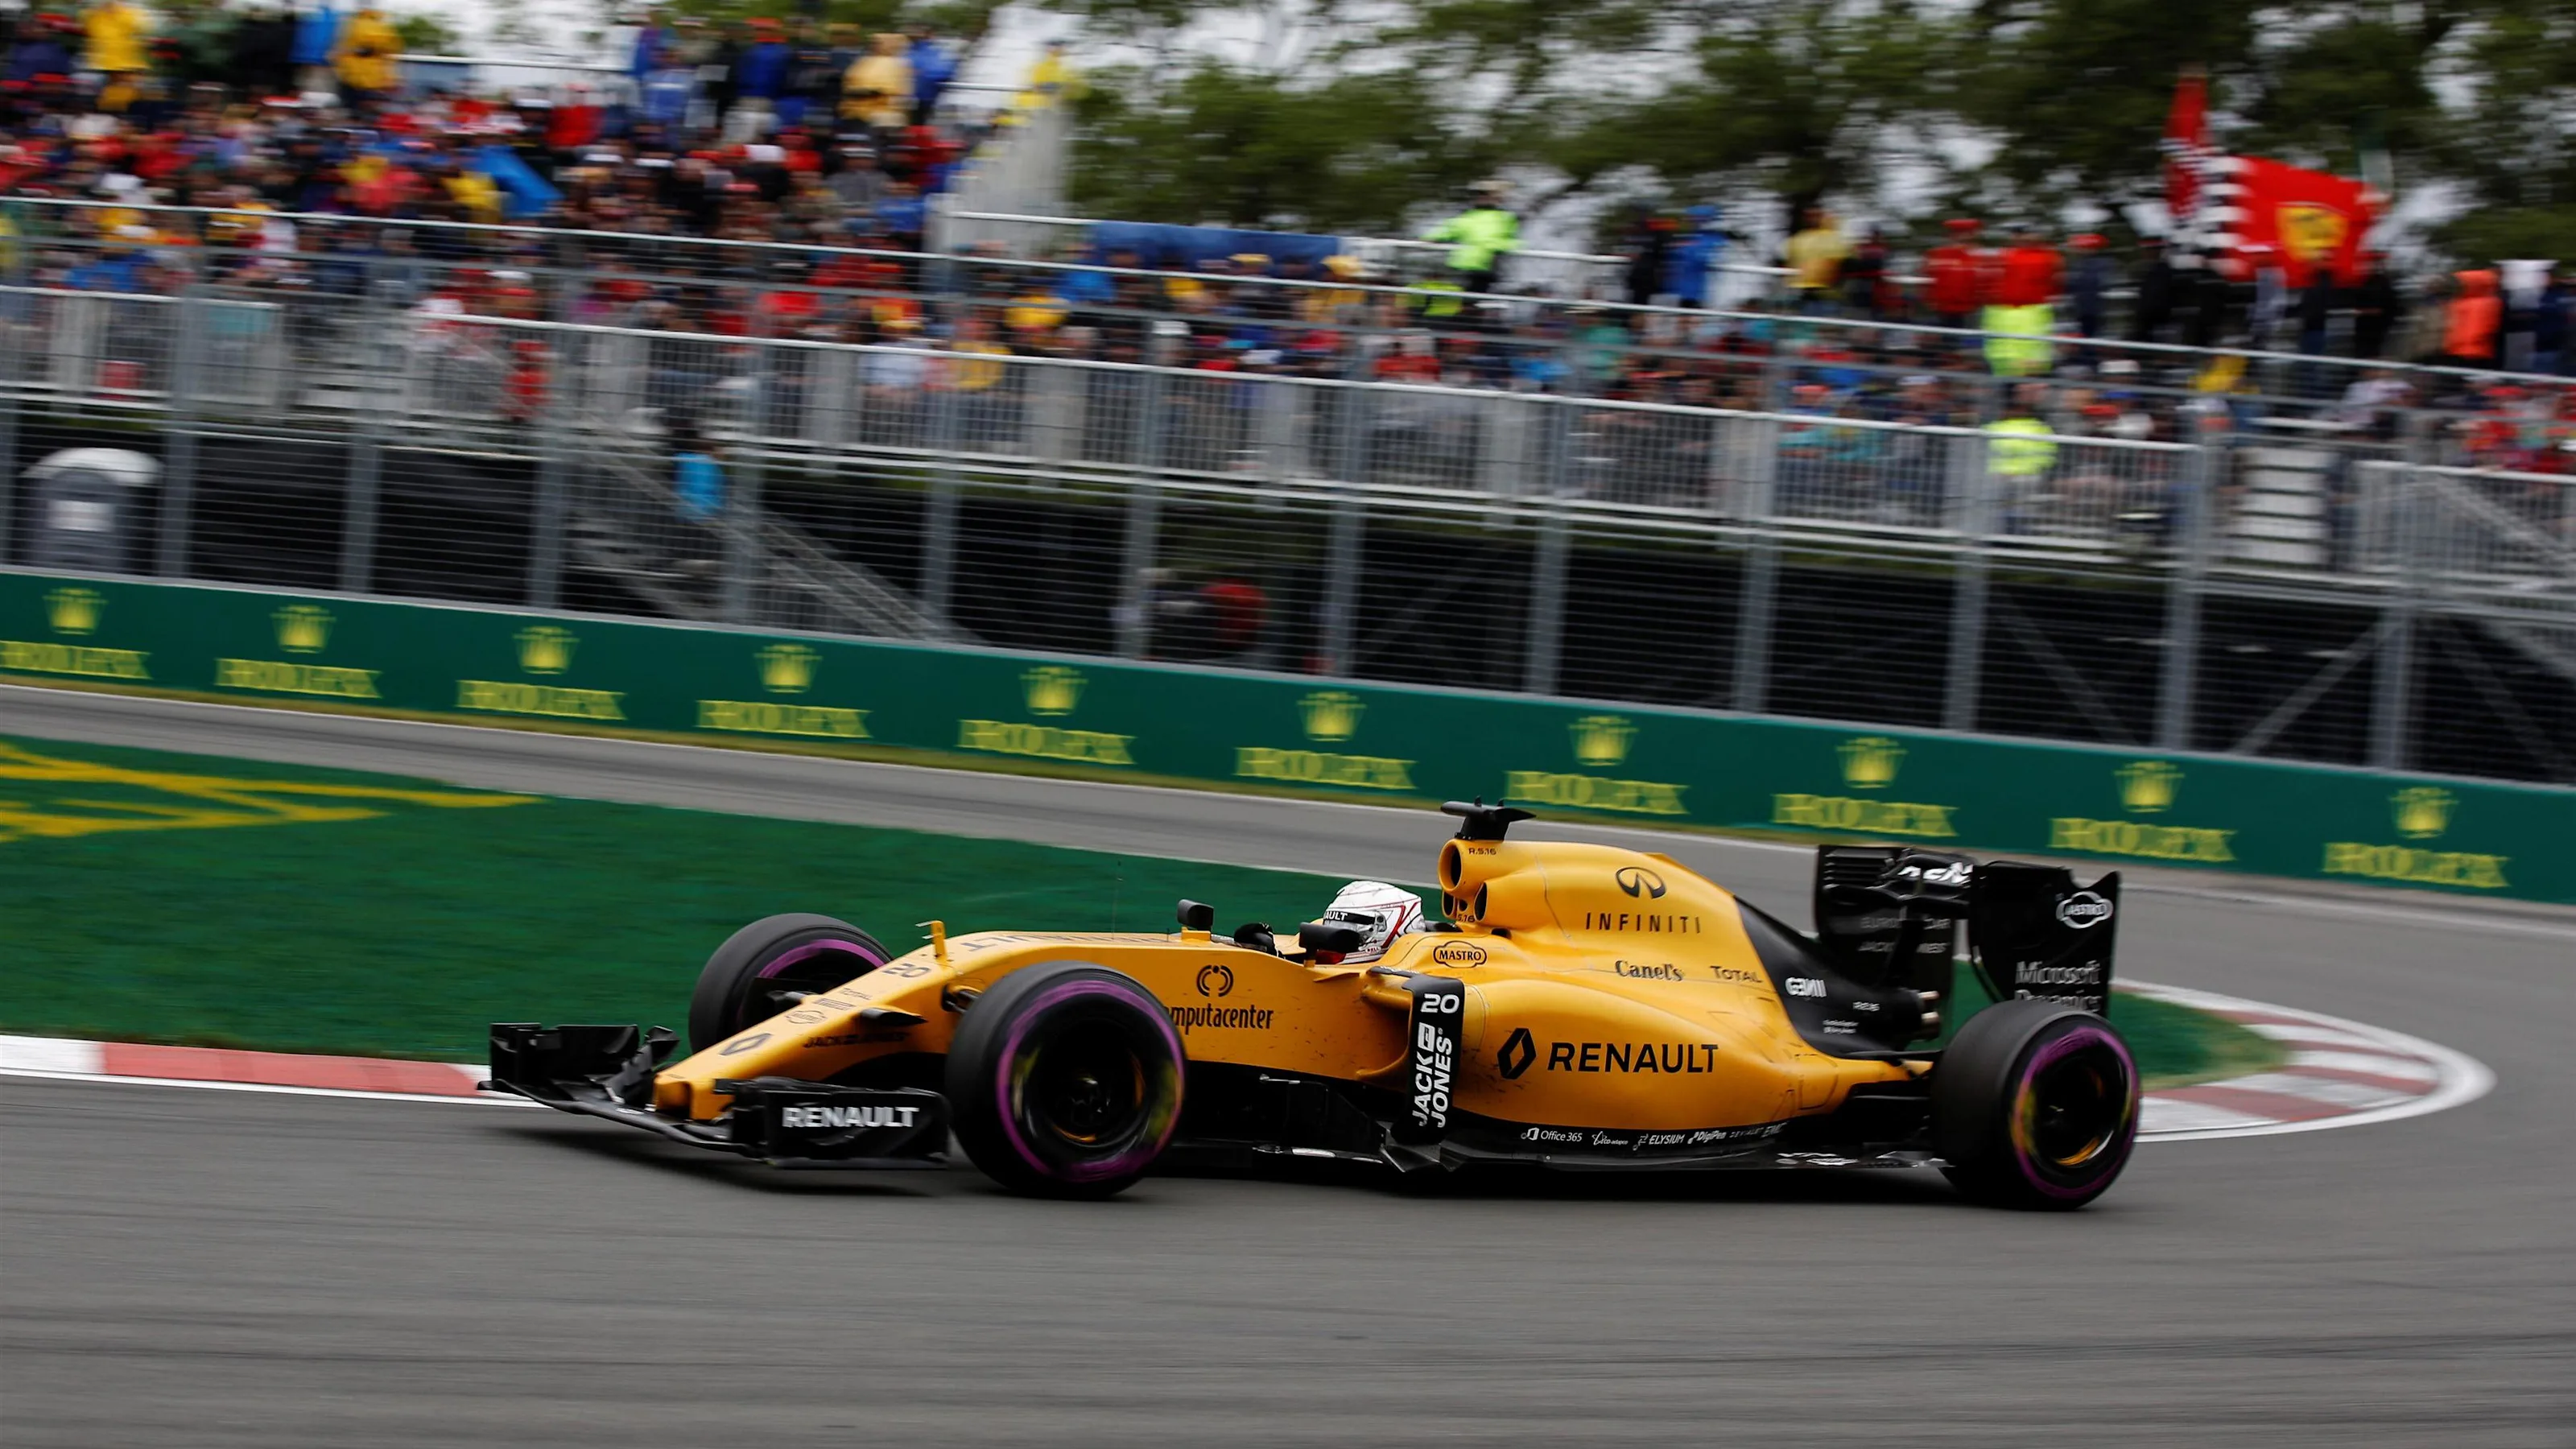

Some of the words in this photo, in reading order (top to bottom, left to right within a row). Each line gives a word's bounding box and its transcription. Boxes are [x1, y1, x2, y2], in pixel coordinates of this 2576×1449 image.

[217, 658, 380, 698] ROLEX
[458, 680, 625, 720] ROLEX
[700, 700, 871, 738] ROLEX
[960, 719, 1135, 765] ROLEX
[1236, 746, 1415, 789] ROLEX
[1507, 770, 1688, 815] ROLEX
[1773, 793, 1958, 836] ROLEX
[2054, 817, 2234, 861] ROLEX
[2325, 843, 2508, 888] ROLEX
[1585, 912, 1701, 934] INFINITI
[1439, 950, 1482, 961] MASTRO
[1615, 960, 1684, 982] Canel's
[2015, 960, 2101, 985] Microsoft
[1710, 965, 1763, 984] TOTAL
[1420, 993, 1459, 1013] 20
[1547, 1043, 1718, 1073] RENAULT
[1412, 1051, 1434, 1127] JACK
[782, 1106, 919, 1128] RENAULT
[1541, 1130, 1566, 1141] Office
[1567, 1132, 1583, 1141] 365
[1649, 1134, 1686, 1145] ELYSIUM
